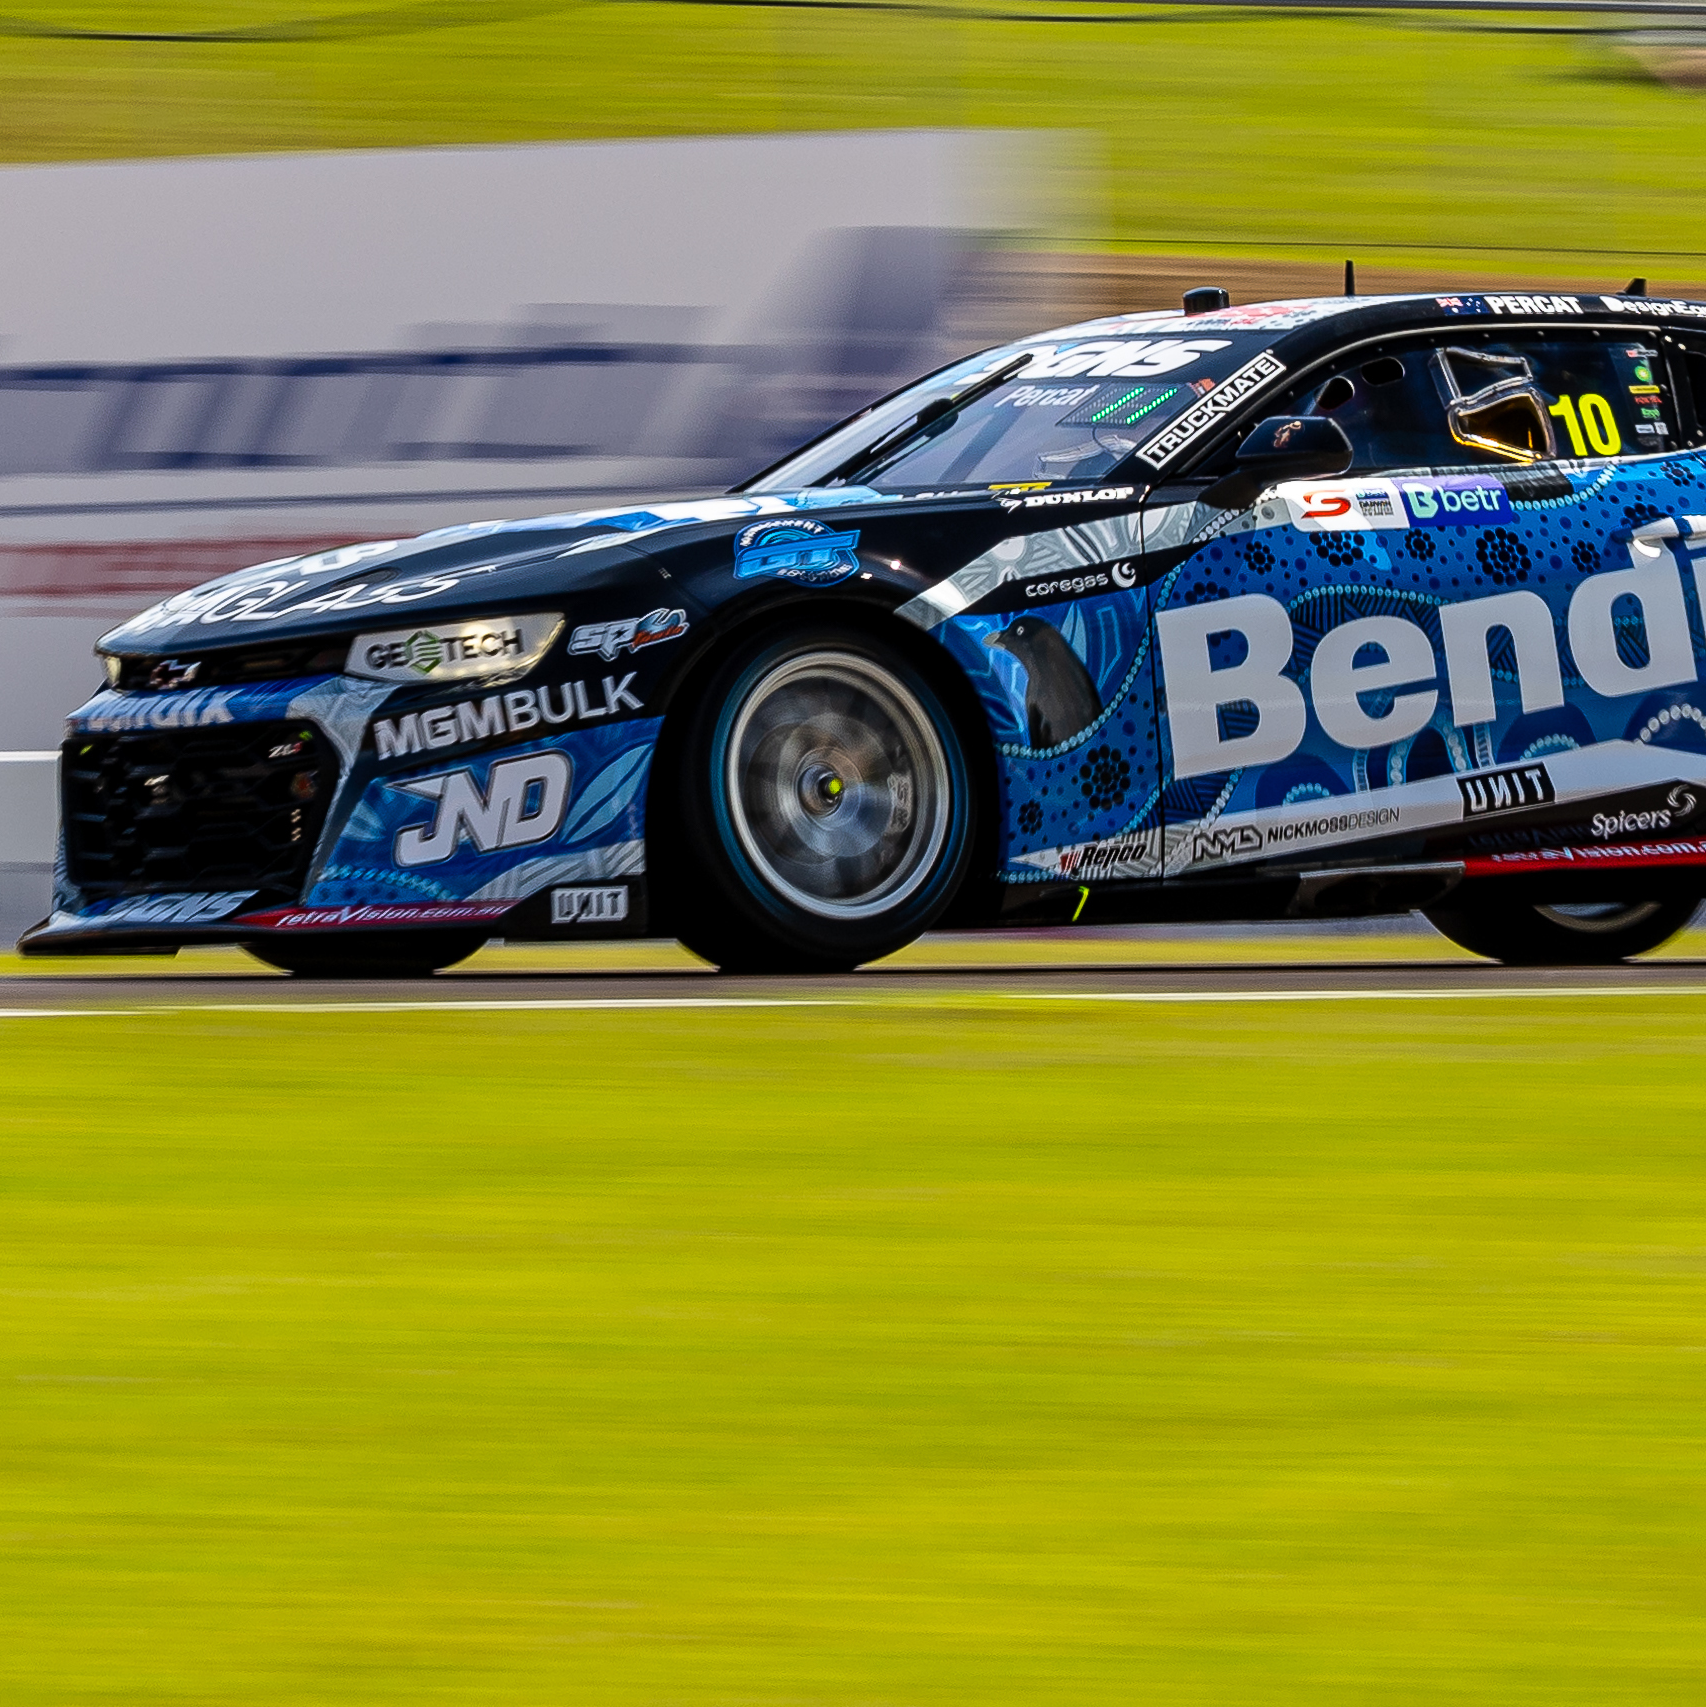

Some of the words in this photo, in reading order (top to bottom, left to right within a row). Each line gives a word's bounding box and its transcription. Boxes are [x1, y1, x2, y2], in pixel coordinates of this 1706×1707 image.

[1483, 295, 1585, 315] PERCAT
[994, 383, 1101, 407] Percat
[1145, 356, 1277, 462] TRUCKMATE
[1548, 393, 1622, 457] 10
[1024, 486, 1135, 508] DUNLOP
[1435, 484, 1502, 512] betr
[1025, 572, 1109, 598] coregas
[373, 671, 645, 761] MGMBULK
[1464, 767, 1546, 814] UNIT
[1590, 808, 1672, 840] Spicers
[1079, 843, 1148, 870] Repco
[556, 890, 623, 918] UNIT
